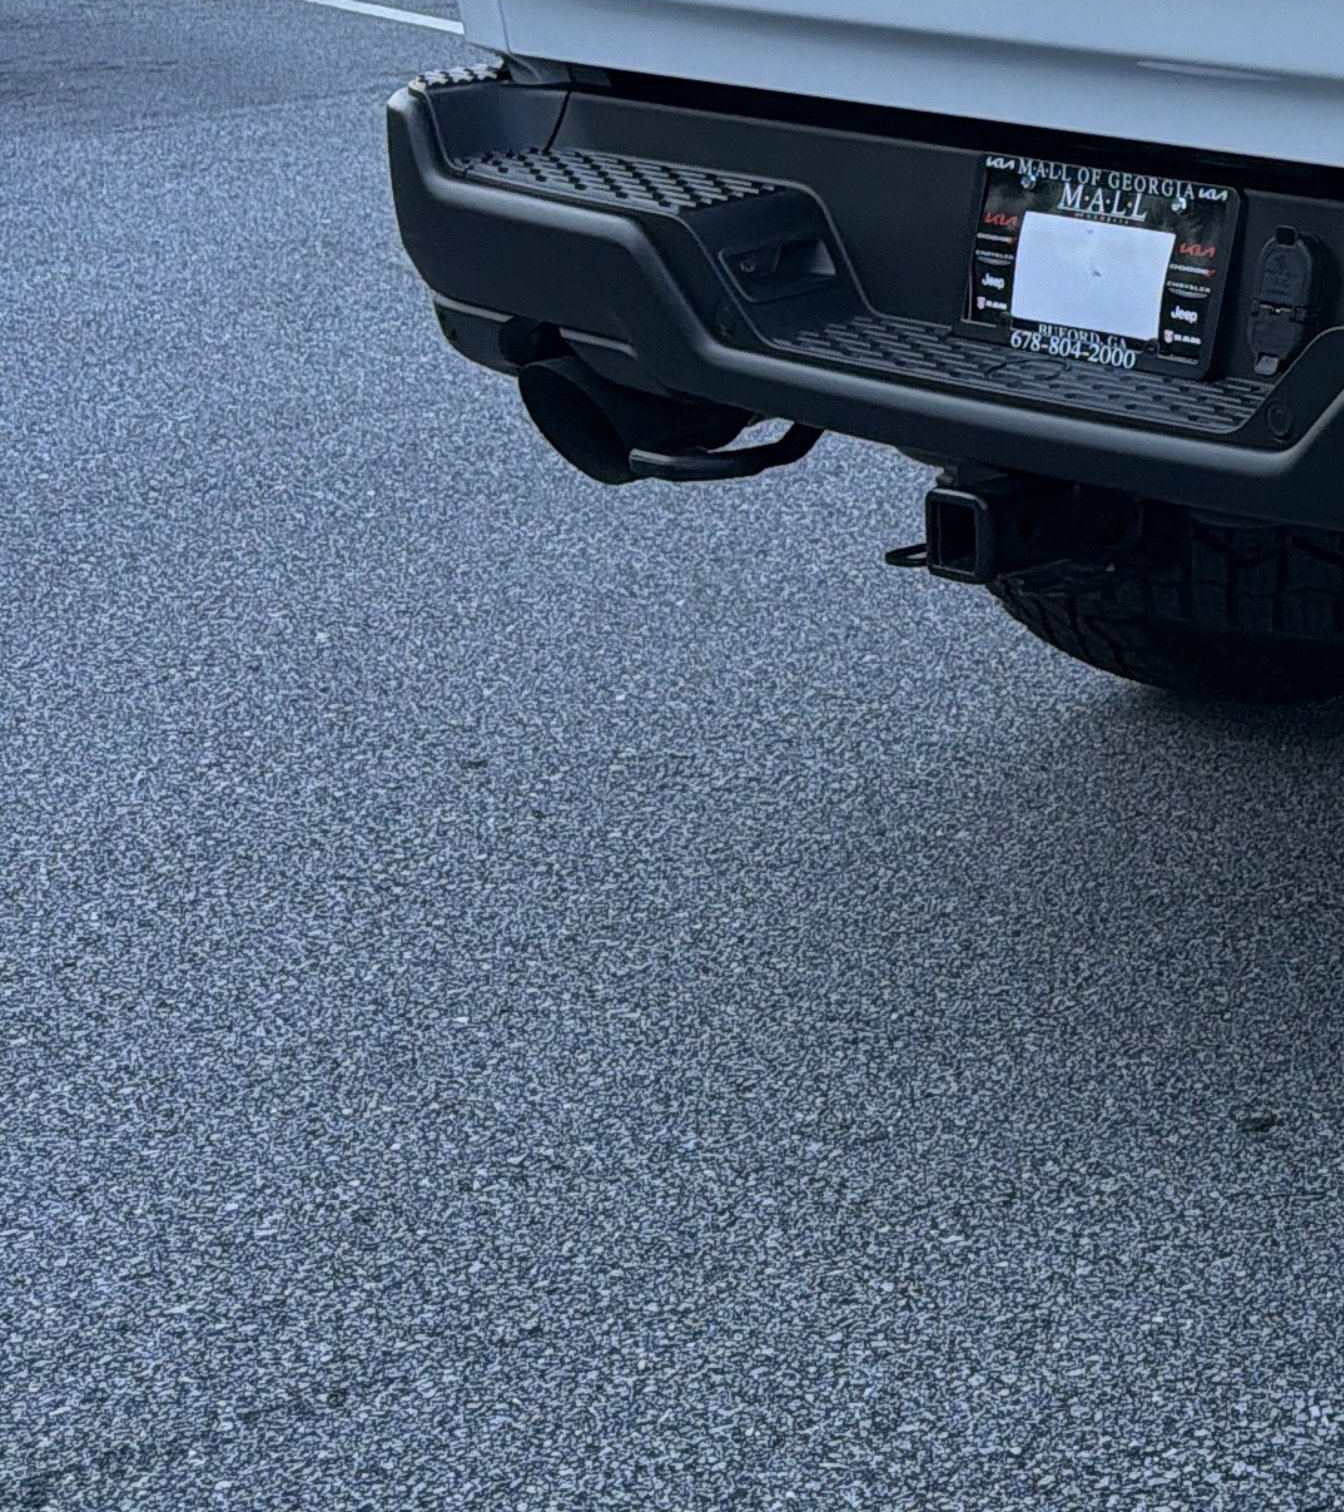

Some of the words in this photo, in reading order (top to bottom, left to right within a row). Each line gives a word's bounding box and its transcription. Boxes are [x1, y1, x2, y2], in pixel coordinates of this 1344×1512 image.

[1078, 167, 1100, 186] OF
[1108, 171, 1195, 199] GEORGIA
[982, 272, 1005, 290] Jeep
[1171, 305, 1198, 324] Jeep
[1010, 330, 1136, 369] 678-804-2000
[1107, 335, 1128, 350] GA
